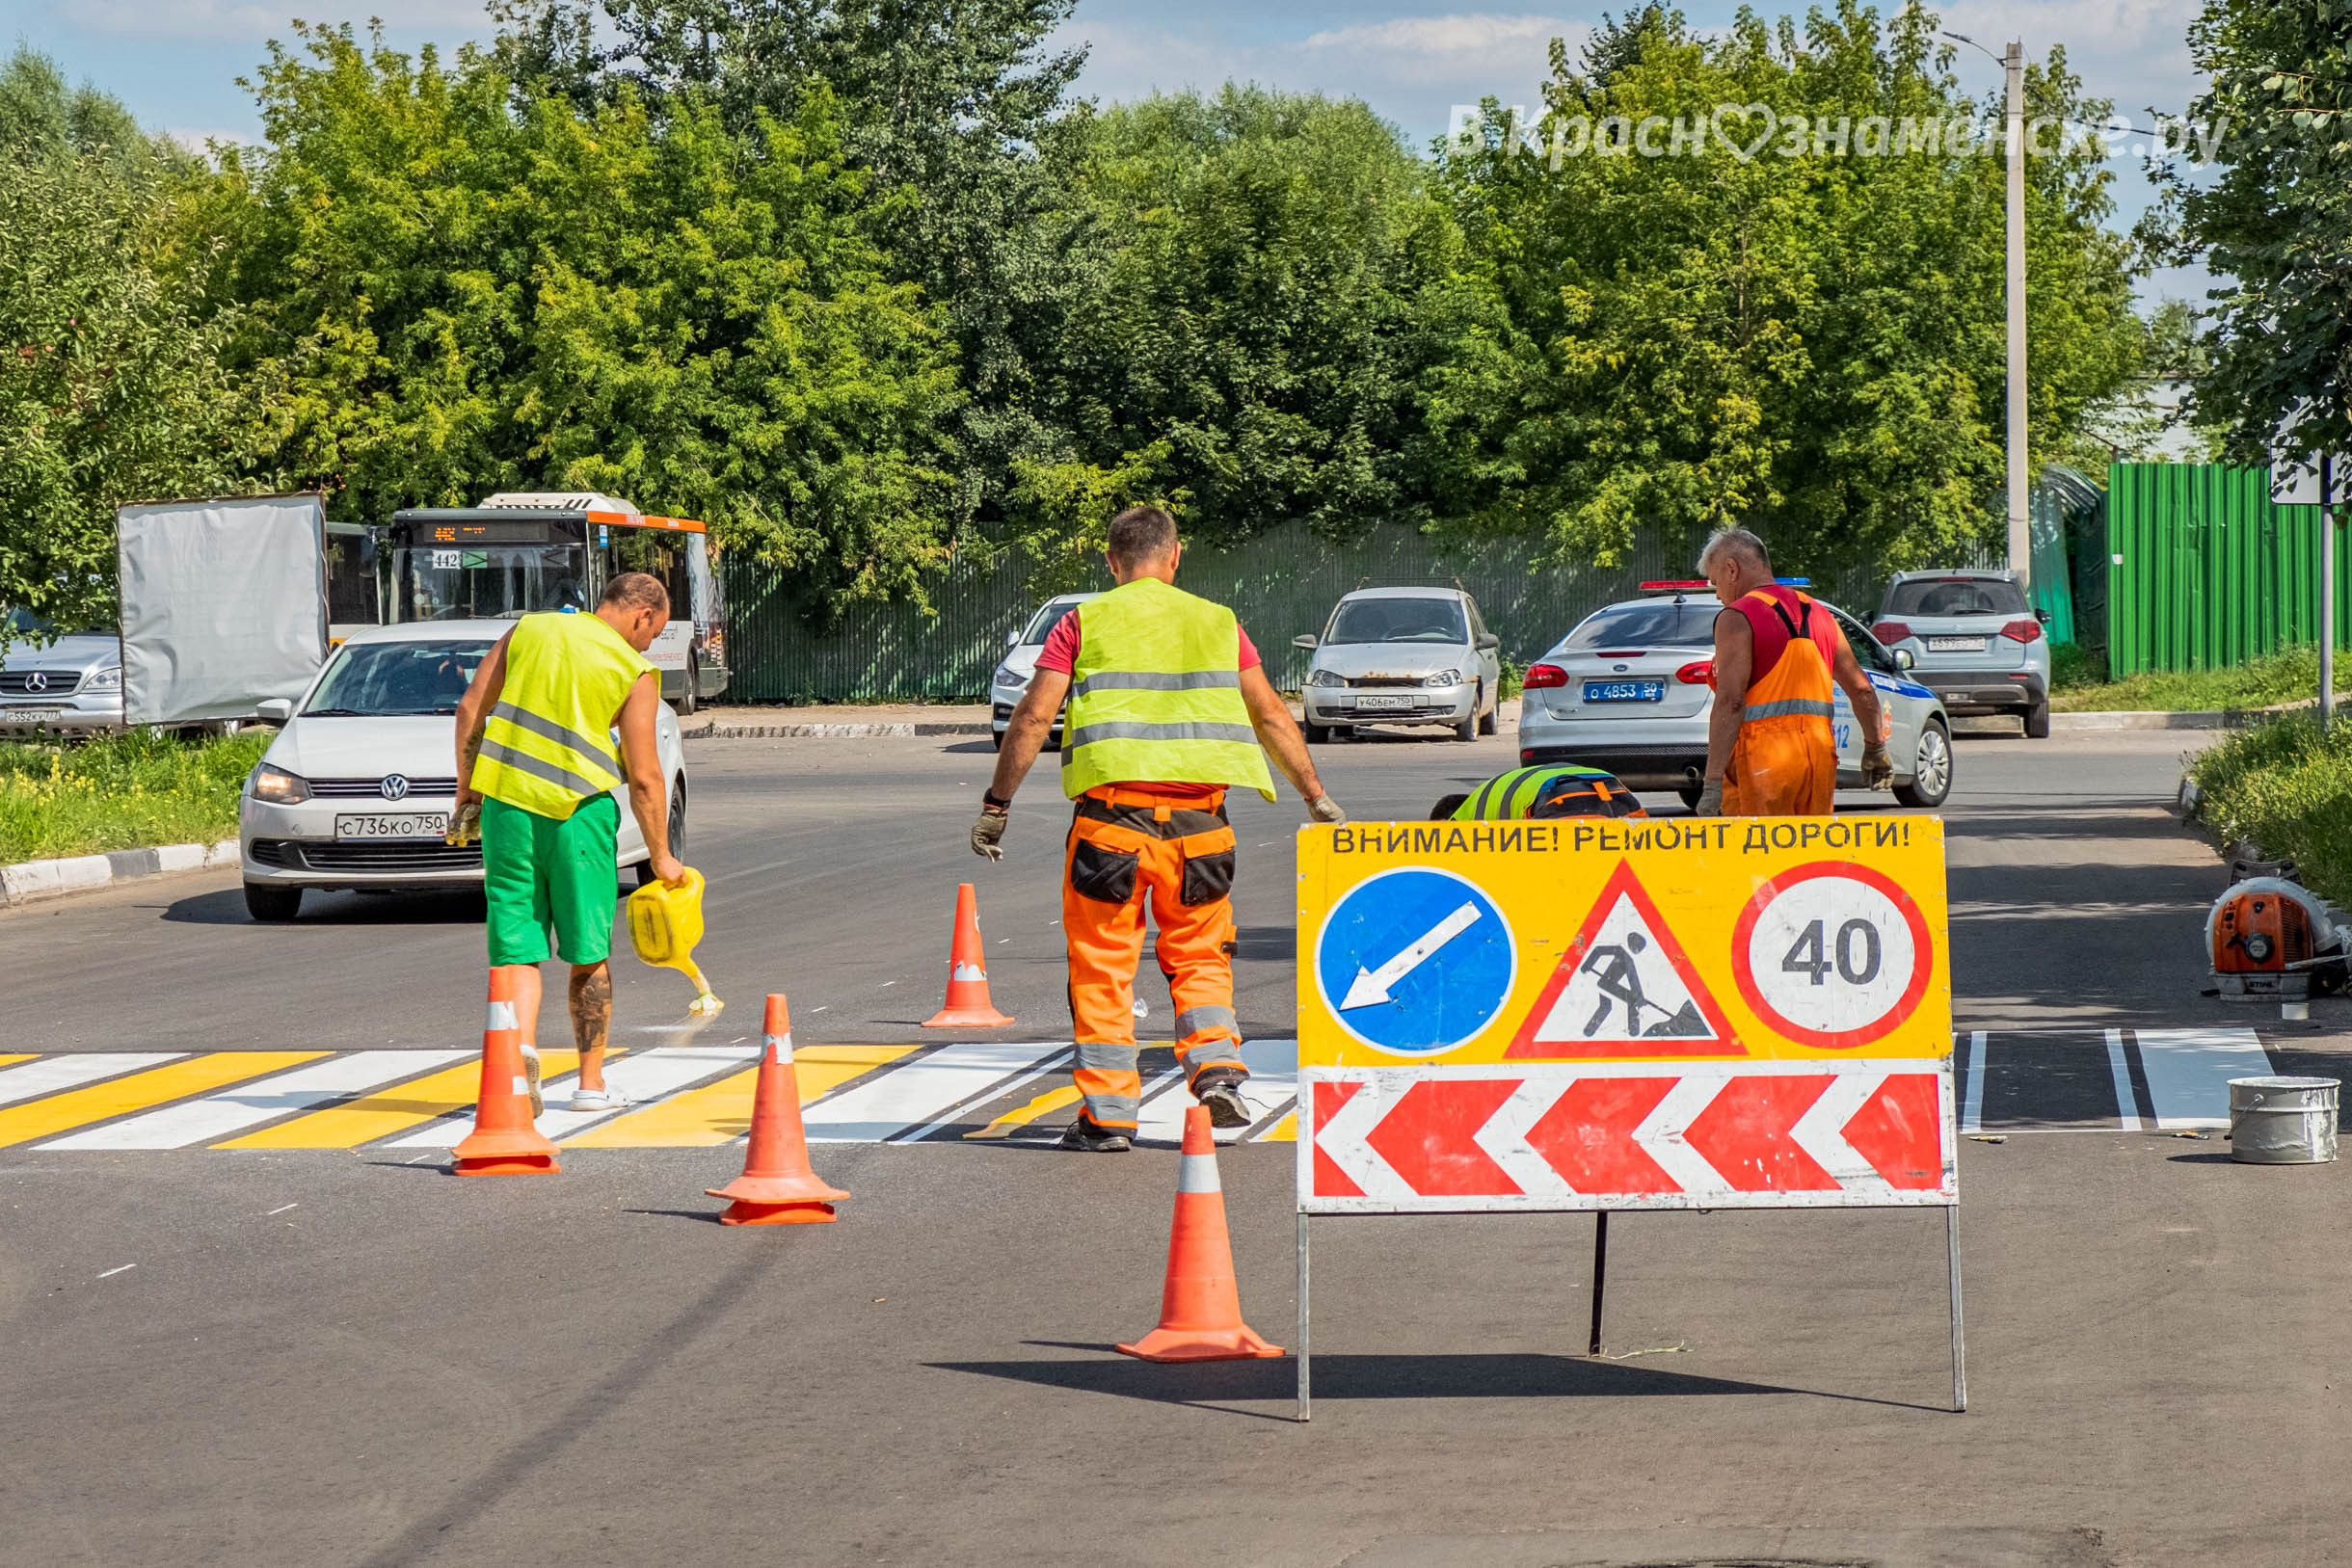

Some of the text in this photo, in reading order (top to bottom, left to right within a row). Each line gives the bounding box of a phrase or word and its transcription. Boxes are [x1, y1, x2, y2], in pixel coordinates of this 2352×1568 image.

[435, 553, 458, 567] 442
[1604, 684, 1636, 698] 4853
[1644, 683, 1657, 693] 50
[342, 816, 442, 836] С736КО 750
[1332, 822, 1910, 855] ВНИМАНИЕ! РЕМОНТ ДОРОГИ!
[1781, 917, 1882, 985] 40
